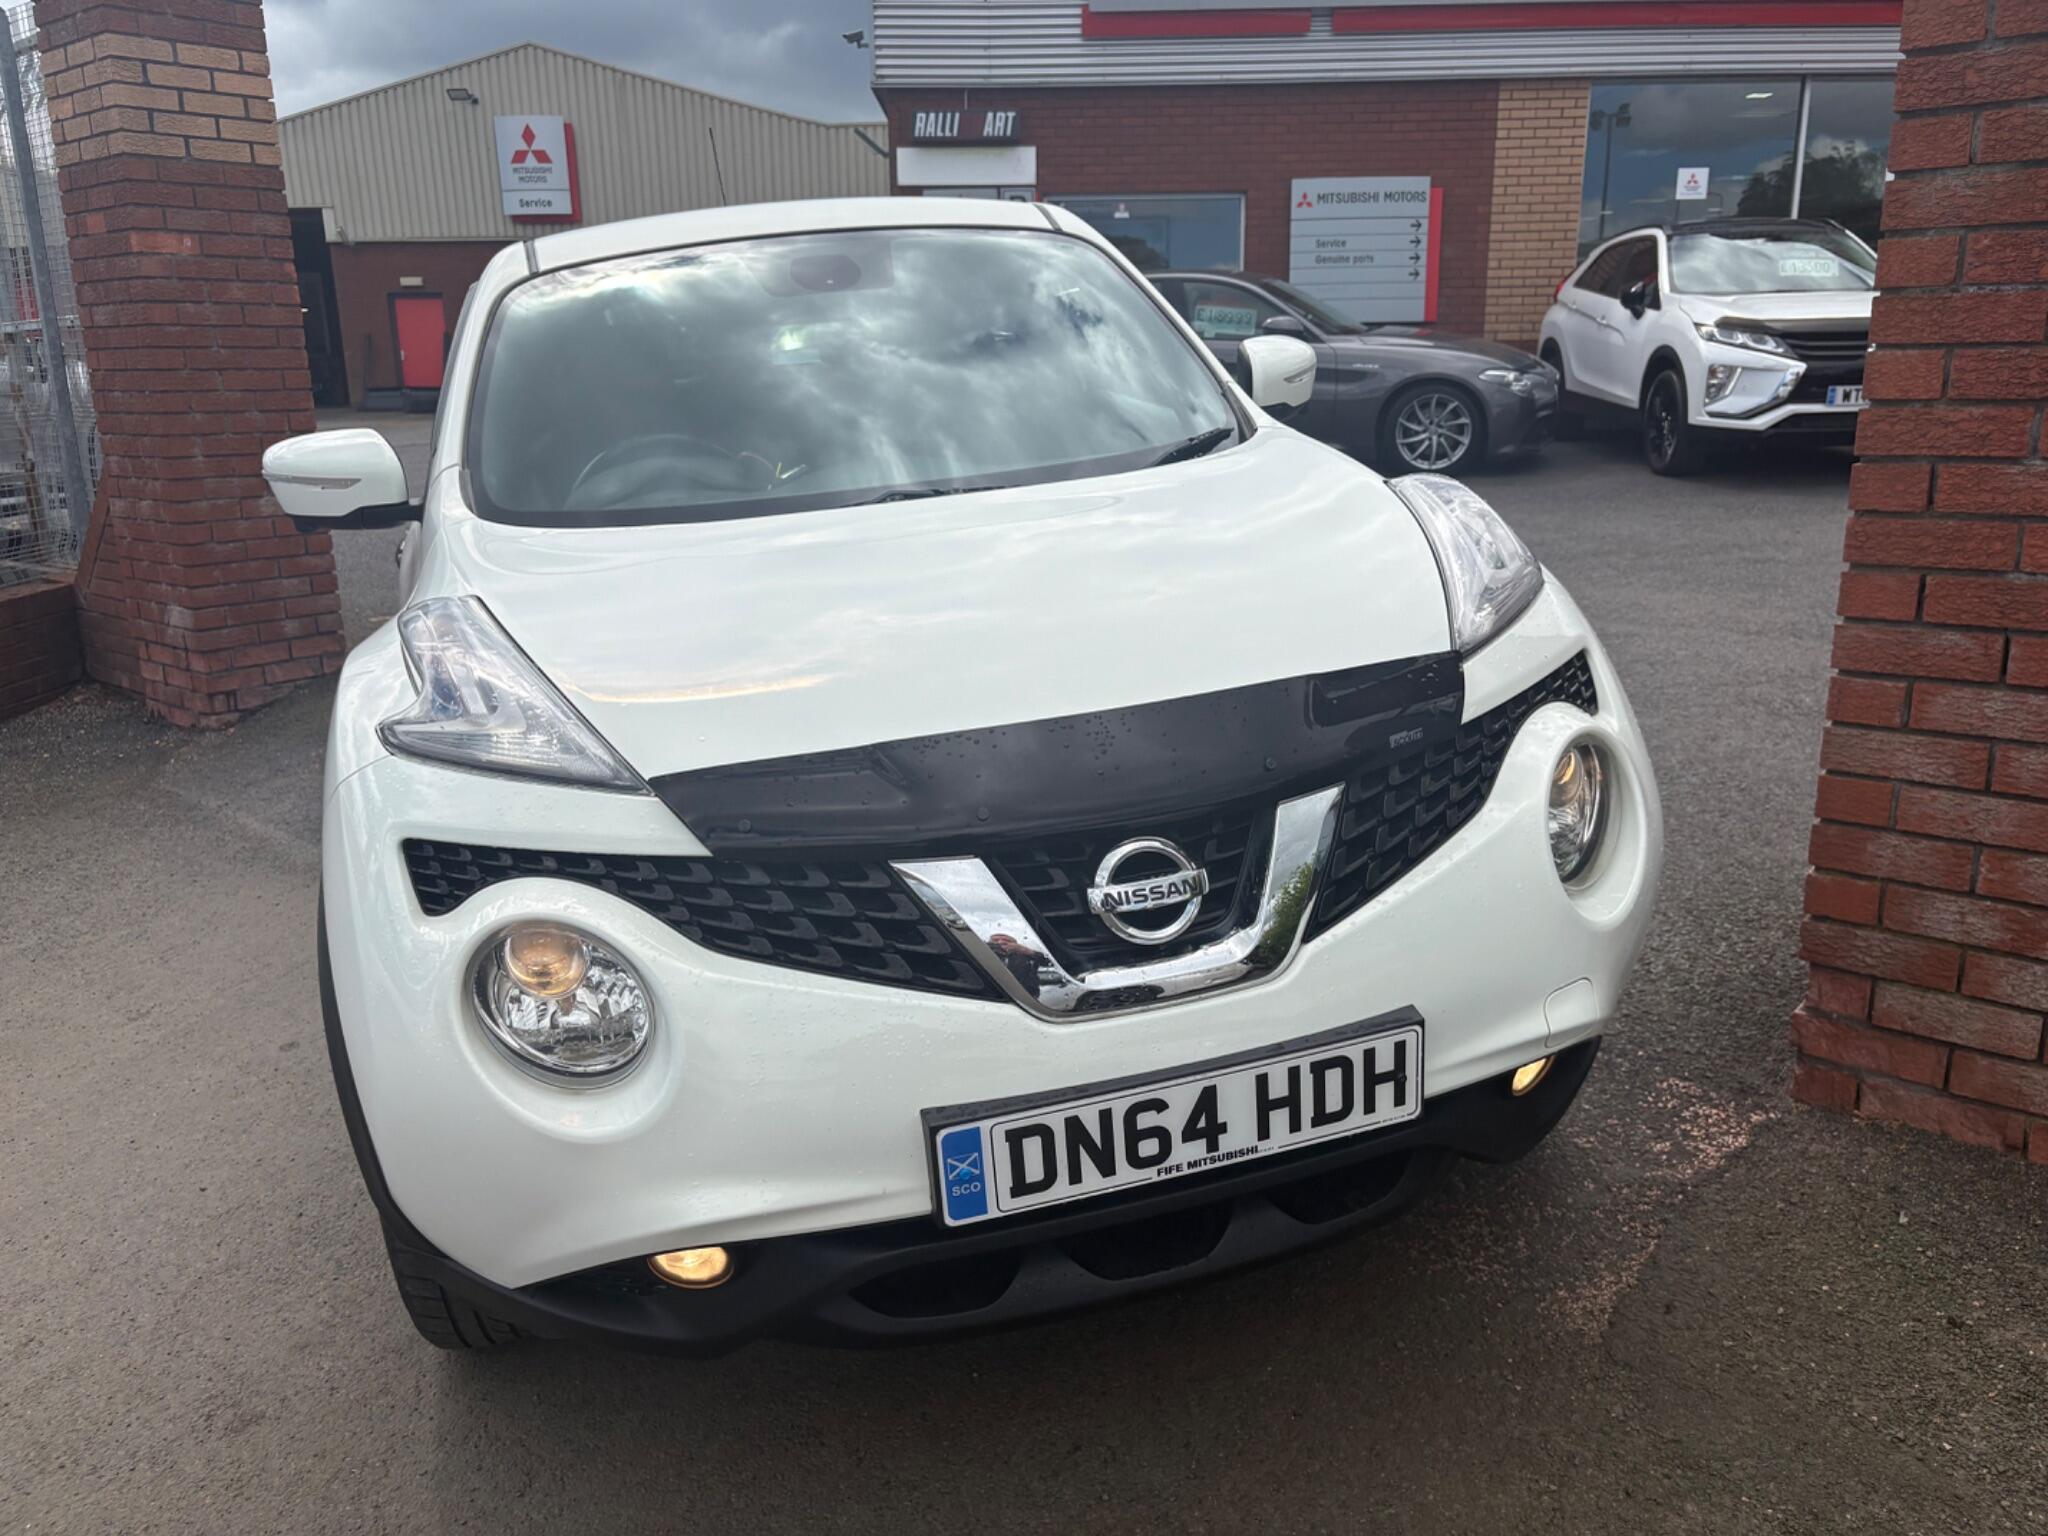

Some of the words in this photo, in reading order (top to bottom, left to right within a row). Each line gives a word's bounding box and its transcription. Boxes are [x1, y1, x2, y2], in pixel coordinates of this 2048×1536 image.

[914, 112, 960, 137] RALLI
[983, 111, 1016, 137] ART
[519, 198, 553, 208] Service
[1317, 192, 1380, 204] MITSUBISHI
[1384, 191, 1427, 203] MOTORS
[1315, 239, 1347, 249] Service
[1315, 254, 1350, 264] Genuine
[1353, 254, 1374, 265] parts
[1101, 876, 1200, 910] NISSAN
[1005, 1084, 1227, 1199] DN64
[1255, 1040, 1407, 1142] HDH
[1157, 1163, 1184, 1177] FIFE
[1187, 1145, 1259, 1170] MITSUBISHI
[952, 1182, 981, 1197] SCO
